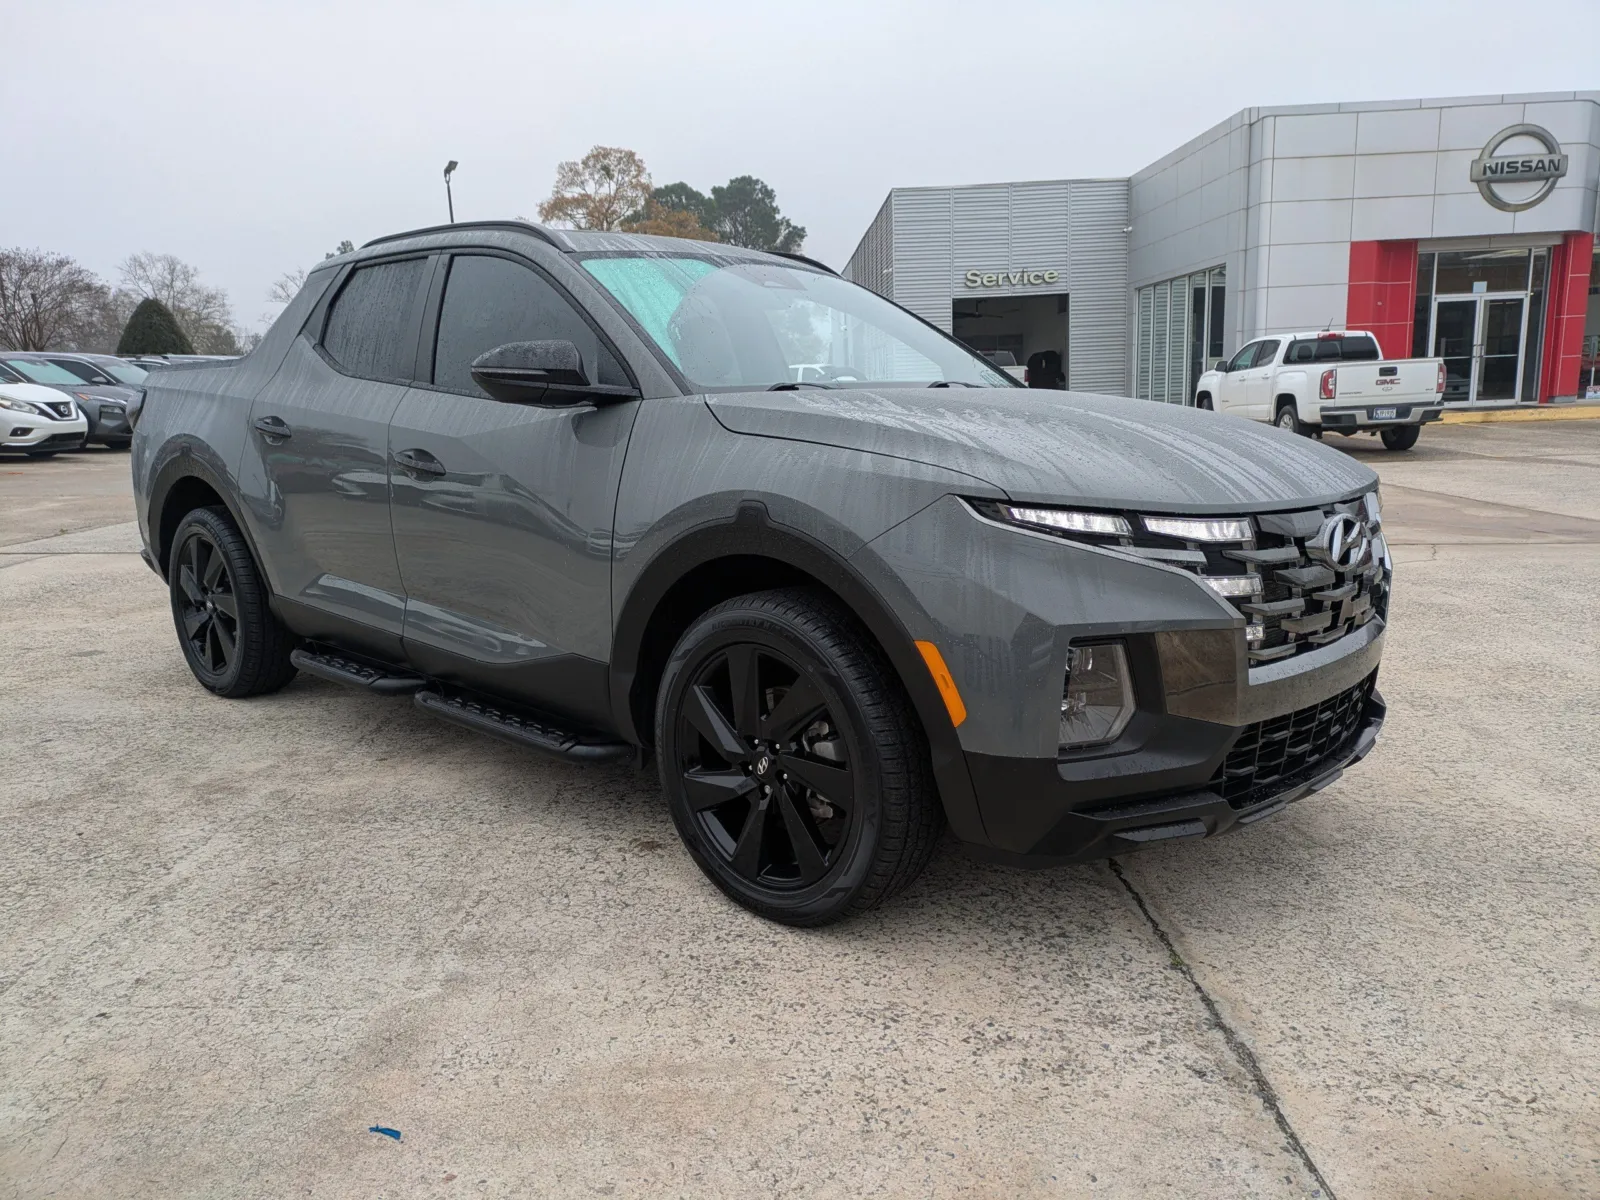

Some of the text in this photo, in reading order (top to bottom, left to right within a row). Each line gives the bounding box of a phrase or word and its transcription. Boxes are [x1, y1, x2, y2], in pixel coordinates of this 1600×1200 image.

[1482, 158, 1561, 176] NISSAN
[965, 268, 1059, 288] Service
[1375, 378, 1401, 386] GMC
